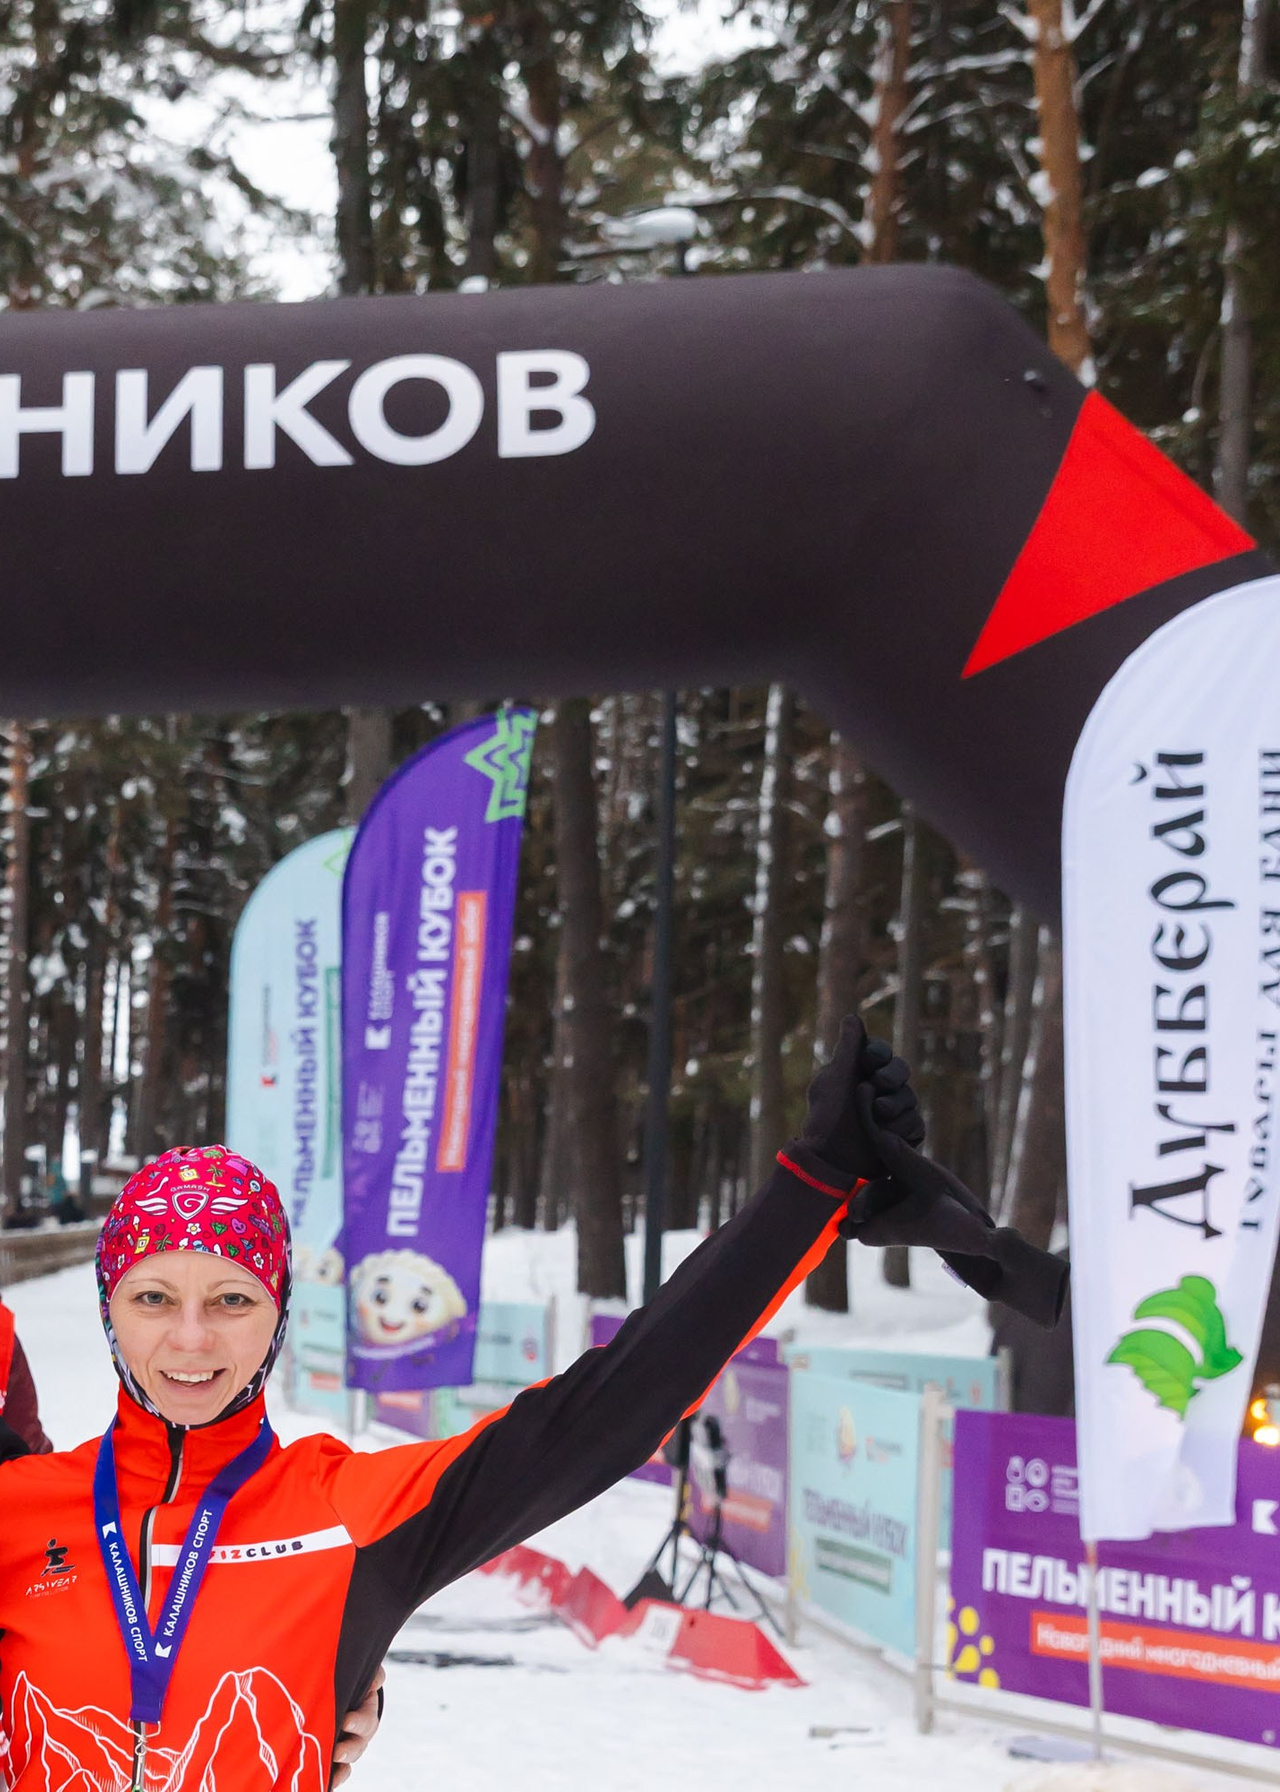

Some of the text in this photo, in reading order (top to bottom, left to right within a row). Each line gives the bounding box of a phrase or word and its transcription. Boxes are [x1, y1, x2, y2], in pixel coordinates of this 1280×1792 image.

[386, 825, 458, 1237] ПЕЛЬМЕННЫЙ КУБОК
[108, 1542, 148, 1662] КАЛАШНИКОВ СПОРТ
[163, 1509, 213, 1637] КАЛАШНИКОВ СПОРТ
[982, 1547, 1255, 1637] ПЕЛЬМЕННЫЙ
[1037, 1622, 1143, 1659] Новогдний
